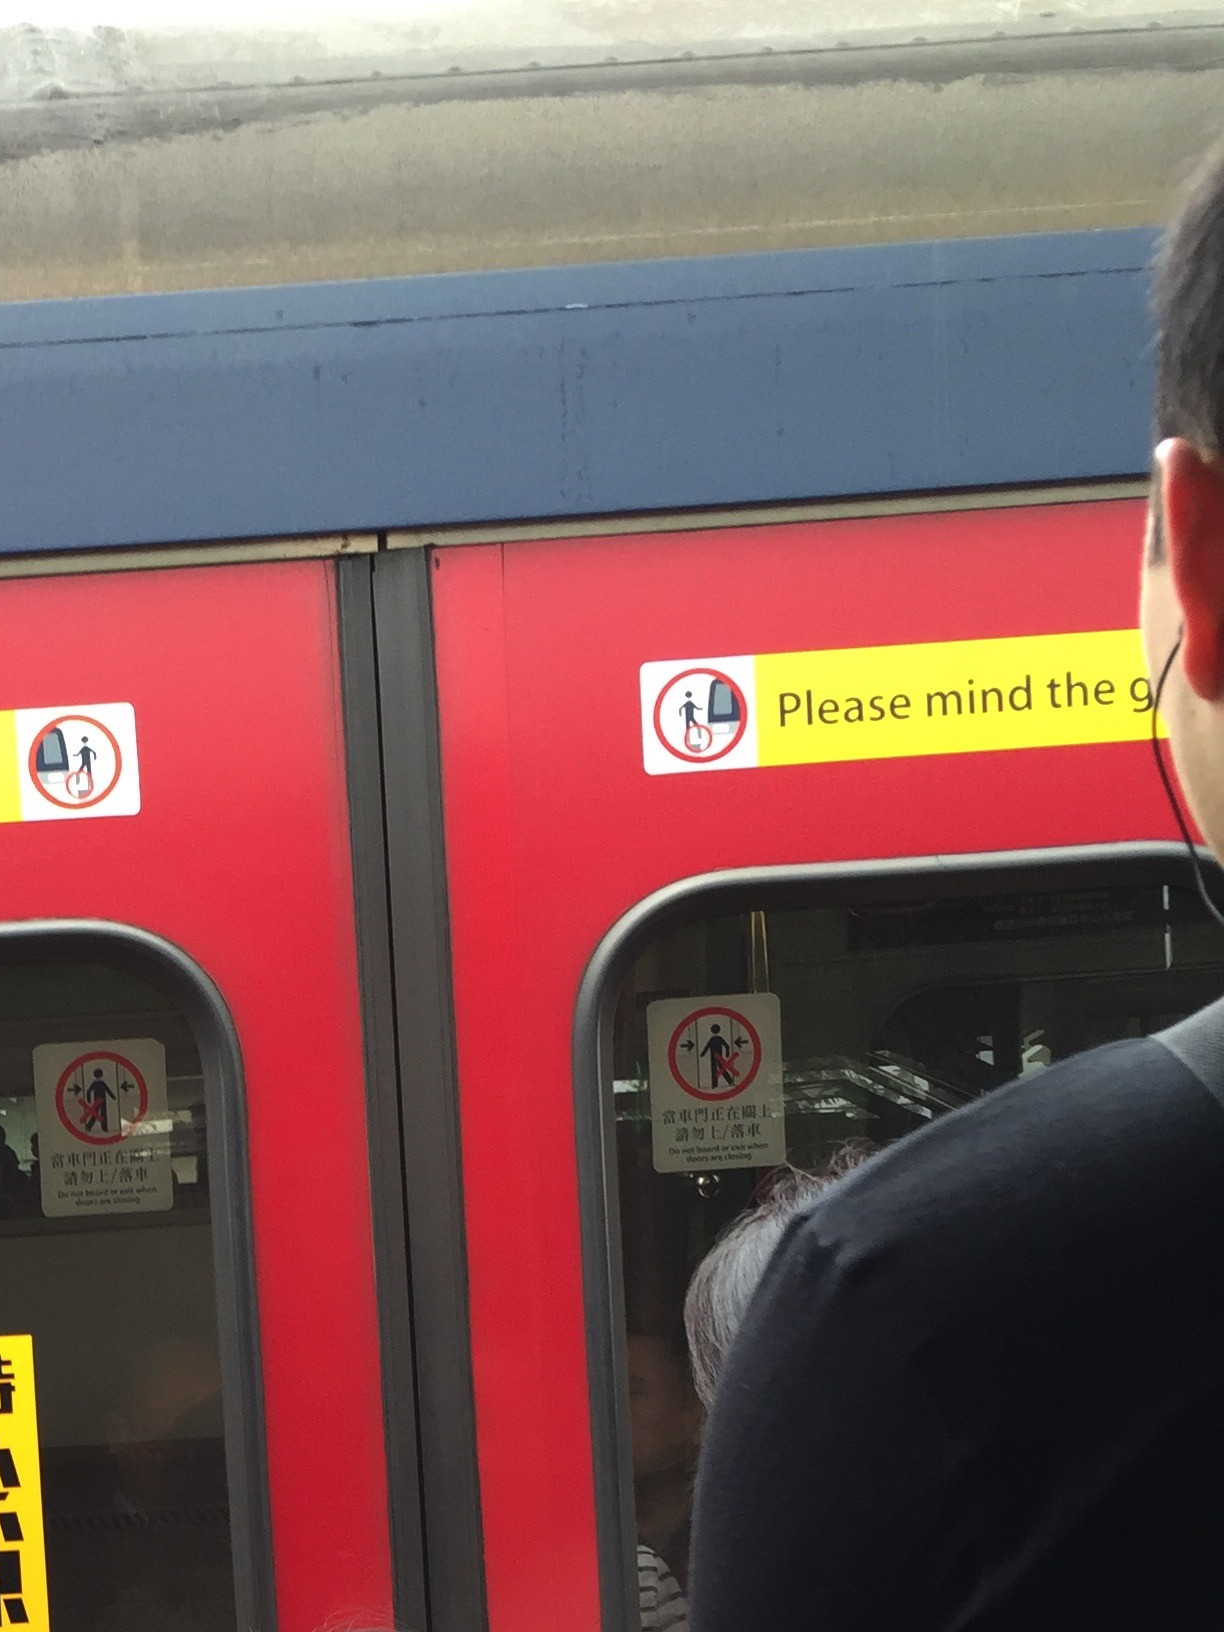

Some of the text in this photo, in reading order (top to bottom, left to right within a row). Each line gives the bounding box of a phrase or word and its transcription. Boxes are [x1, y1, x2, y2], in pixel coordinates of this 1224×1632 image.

[779, 689, 911, 727] Please
[926, 674, 1032, 717] mind
[1046, 671, 1115, 708] the
